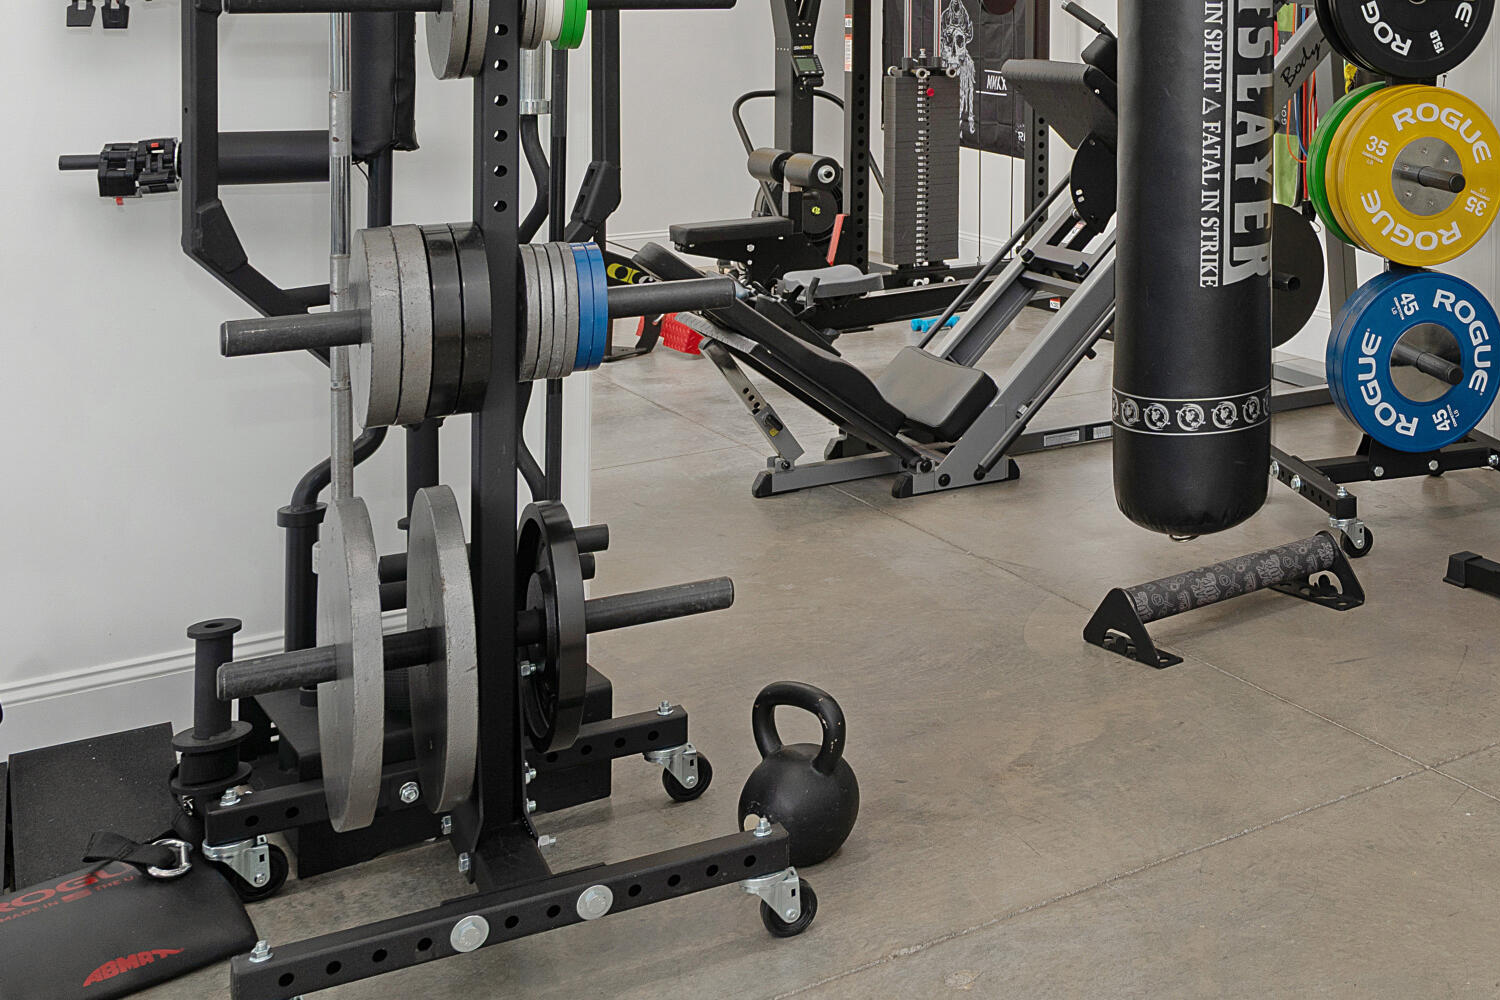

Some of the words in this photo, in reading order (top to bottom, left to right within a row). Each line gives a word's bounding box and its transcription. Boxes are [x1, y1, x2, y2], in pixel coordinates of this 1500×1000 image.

[1204, 1, 1223, 25] IN
[1203, 29, 1223, 93] SPIRIT
[1429, 29, 1445, 54] 15LB
[1202, 120, 1222, 186] FATAL
[1366, 135, 1390, 157] 35
[1392, 102, 1492, 164] ROGUE
[1201, 189, 1220, 213] IN
[1360, 189, 1463, 251] ROGUE
[1464, 196, 1488, 217] 35
[1200, 217, 1220, 288] STRIKE
[1400, 293, 1420, 316] 45
[1432, 288, 1492, 396] ROGUE
[1358, 327, 1419, 438] ROGUE
[1431, 408, 1451, 431] 45
